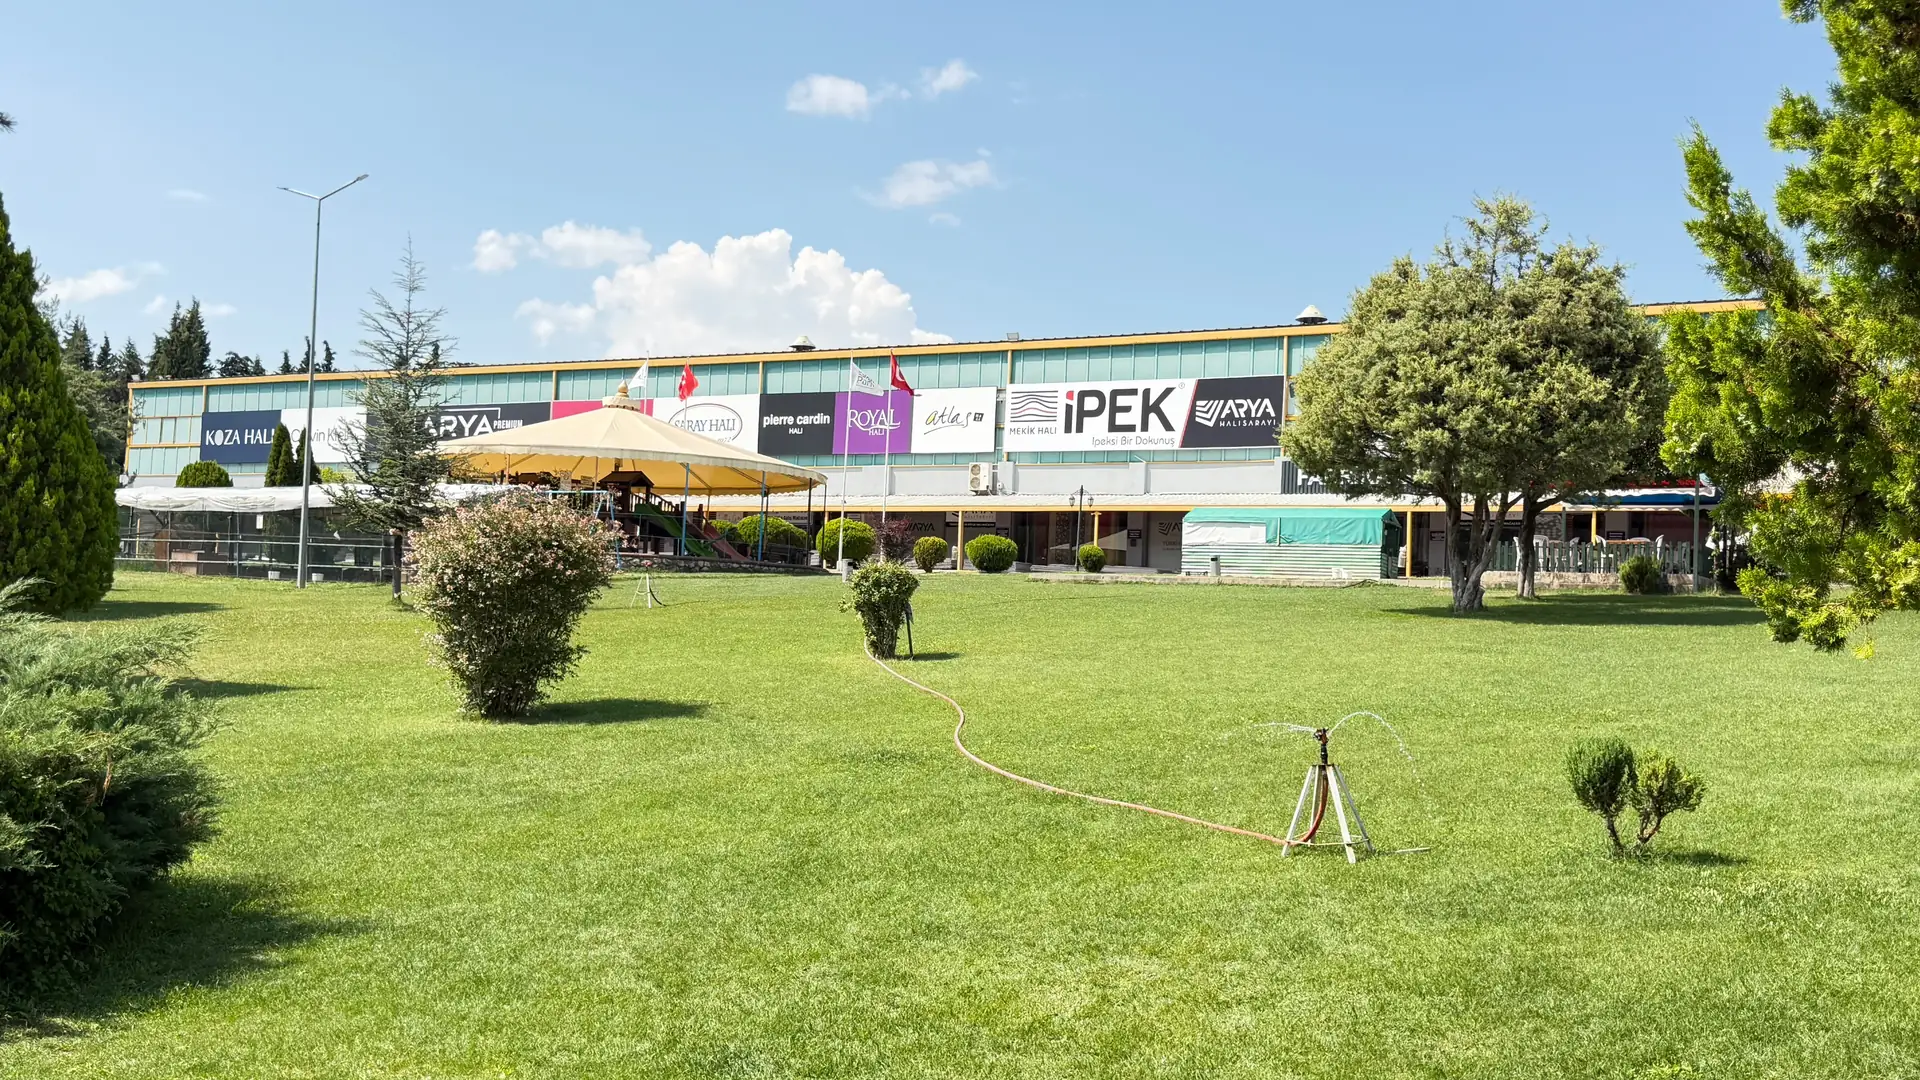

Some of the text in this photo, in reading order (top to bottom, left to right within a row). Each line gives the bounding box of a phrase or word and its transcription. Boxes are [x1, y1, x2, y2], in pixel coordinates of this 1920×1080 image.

[1220, 398, 1276, 419] ARYA
[424, 414, 523, 437] ARYA PREMIUM
[674, 418, 736, 432] SARAY HALI
[763, 412, 831, 428] pierre cardin
[848, 408, 901, 431] ROYAL
[924, 405, 972, 430] atlas
[205, 429, 241, 446] KOZA
[244, 428, 275, 445] HALI
[1009, 425, 1057, 435] MEKİK HALI
[1120, 436, 1133, 446] Bir
[1135, 435, 1175, 447] Dokunuş
[913, 522, 935, 531] ARYA
